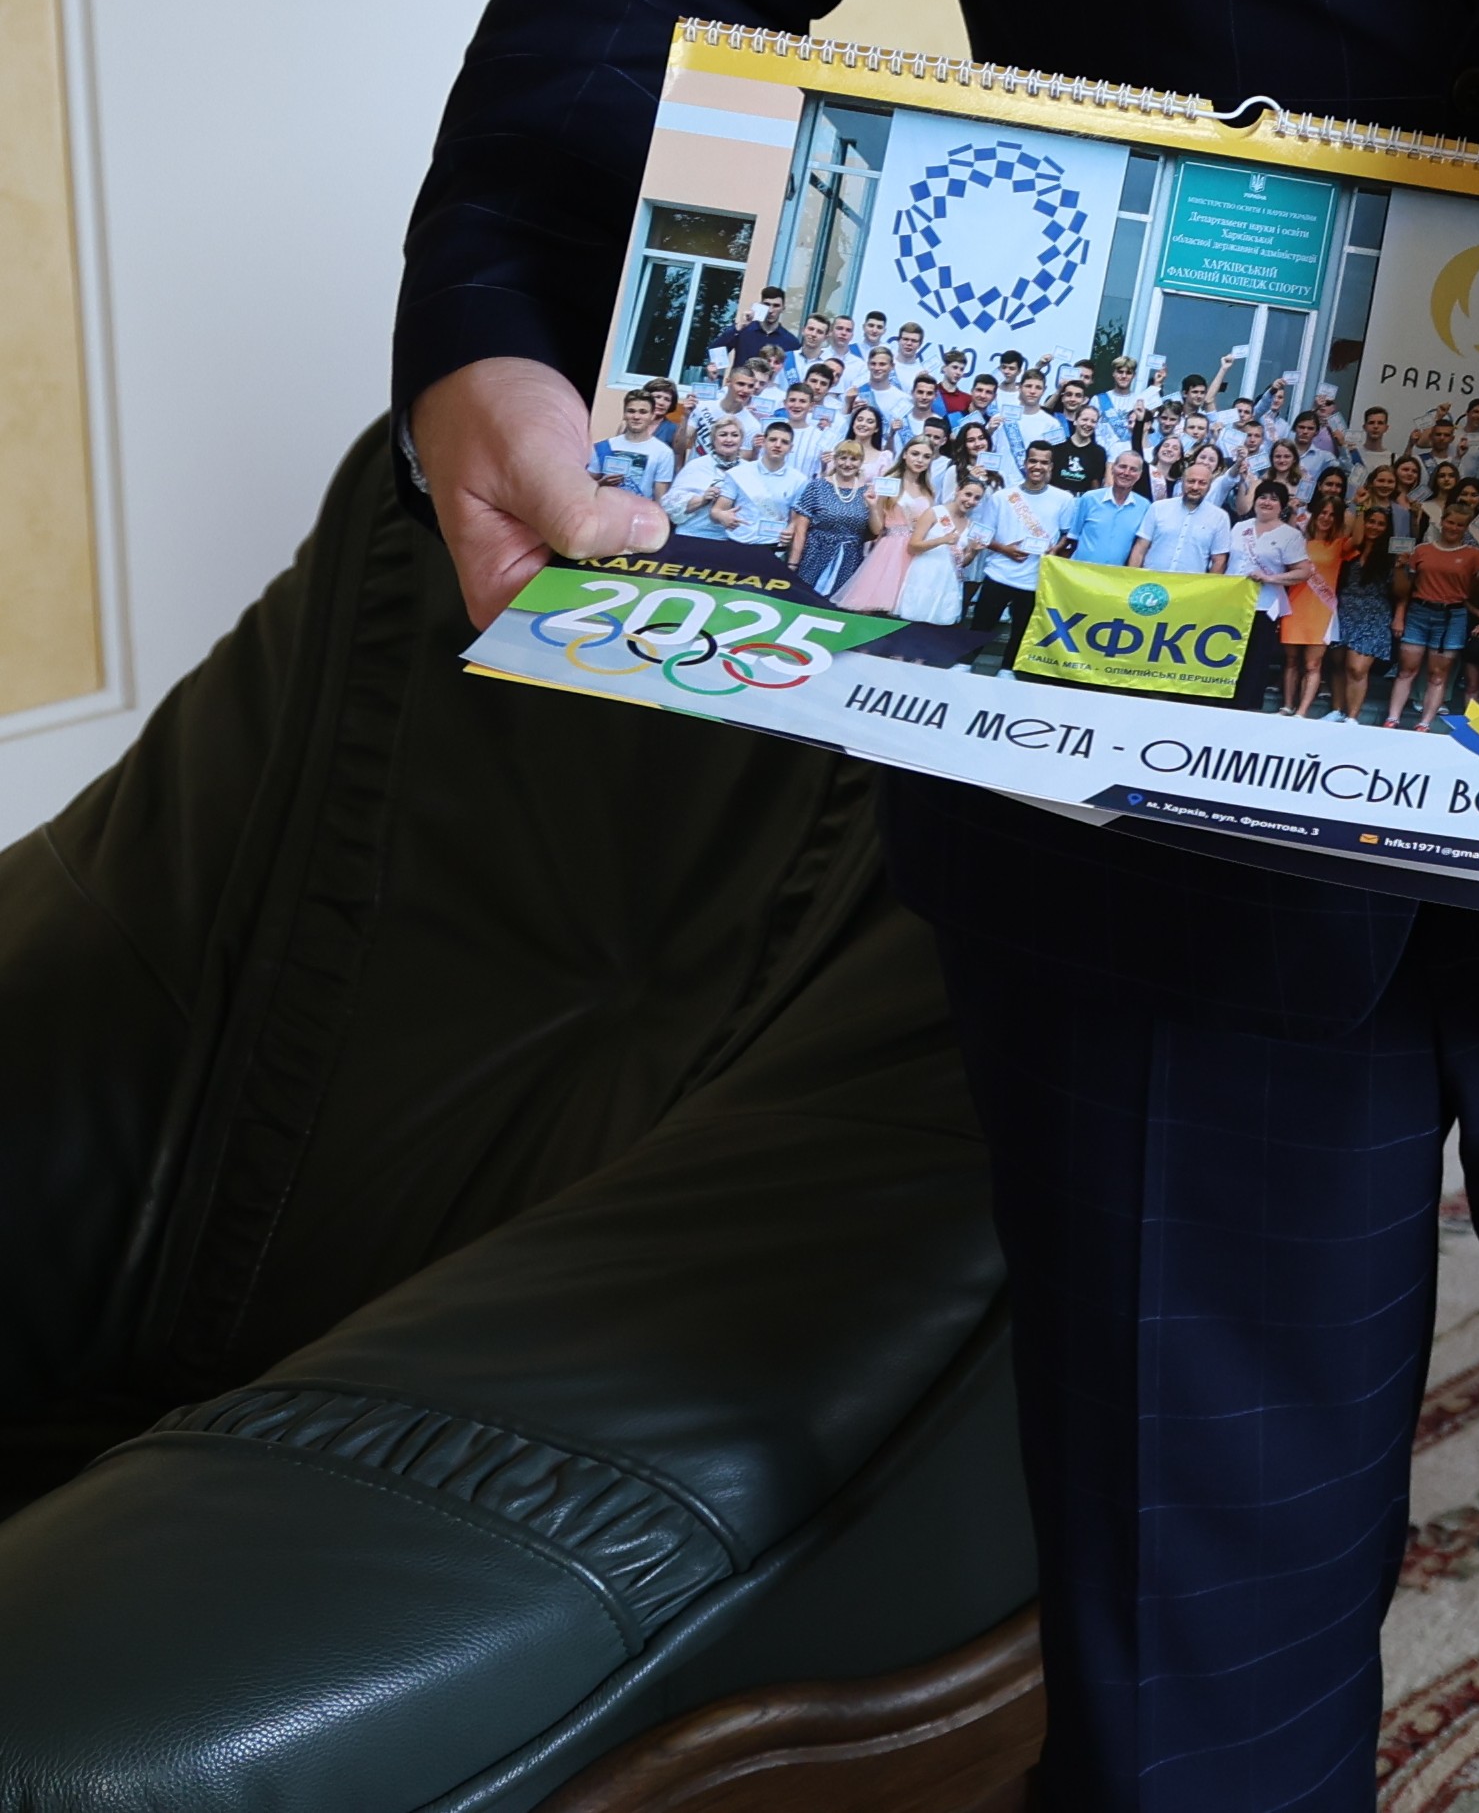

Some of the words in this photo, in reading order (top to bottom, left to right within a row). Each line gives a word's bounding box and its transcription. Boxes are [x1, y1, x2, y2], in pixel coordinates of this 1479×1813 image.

[1188, 211, 1247, 230] Департамент
[1249, 221, 1275, 234] науки
[1281, 226, 1310, 238] освіти
[1220, 228, 1274, 245] Харківської
[1172, 233, 1211, 248] обласної
[1212, 241, 1259, 256] державної
[1260, 247, 1318, 264] адміністрації
[1166, 265, 1220, 284] ФАХОВИЙ
[1221, 273, 1267, 291] КОЛЕДЖ
[1269, 280, 1313, 296] СПОРТУ
[1202, 258, 1279, 278] ХАРКІВСЬКИЙ
[577, 556, 791, 591] КАЛЕНДАР
[543, 580, 846, 676] 2025
[1035, 607, 1242, 668] ХФКС
[1028, 654, 1059, 666] НАША
[1062, 661, 1092, 671] МЕТА
[1105, 666, 1176, 680] ОЛІМПІЙСЬКІ
[845, 684, 949, 730] НАША
[1140, 740, 1431, 810] ОЛІМПІЙСЬКІ
[1146, 801, 1160, 809] м.
[1162, 802, 1209, 819] Харків,
[1211, 813, 1238, 823] вул.
[1240, 815, 1308, 836] Фронтова,
[1310, 827, 1320, 836] 3
